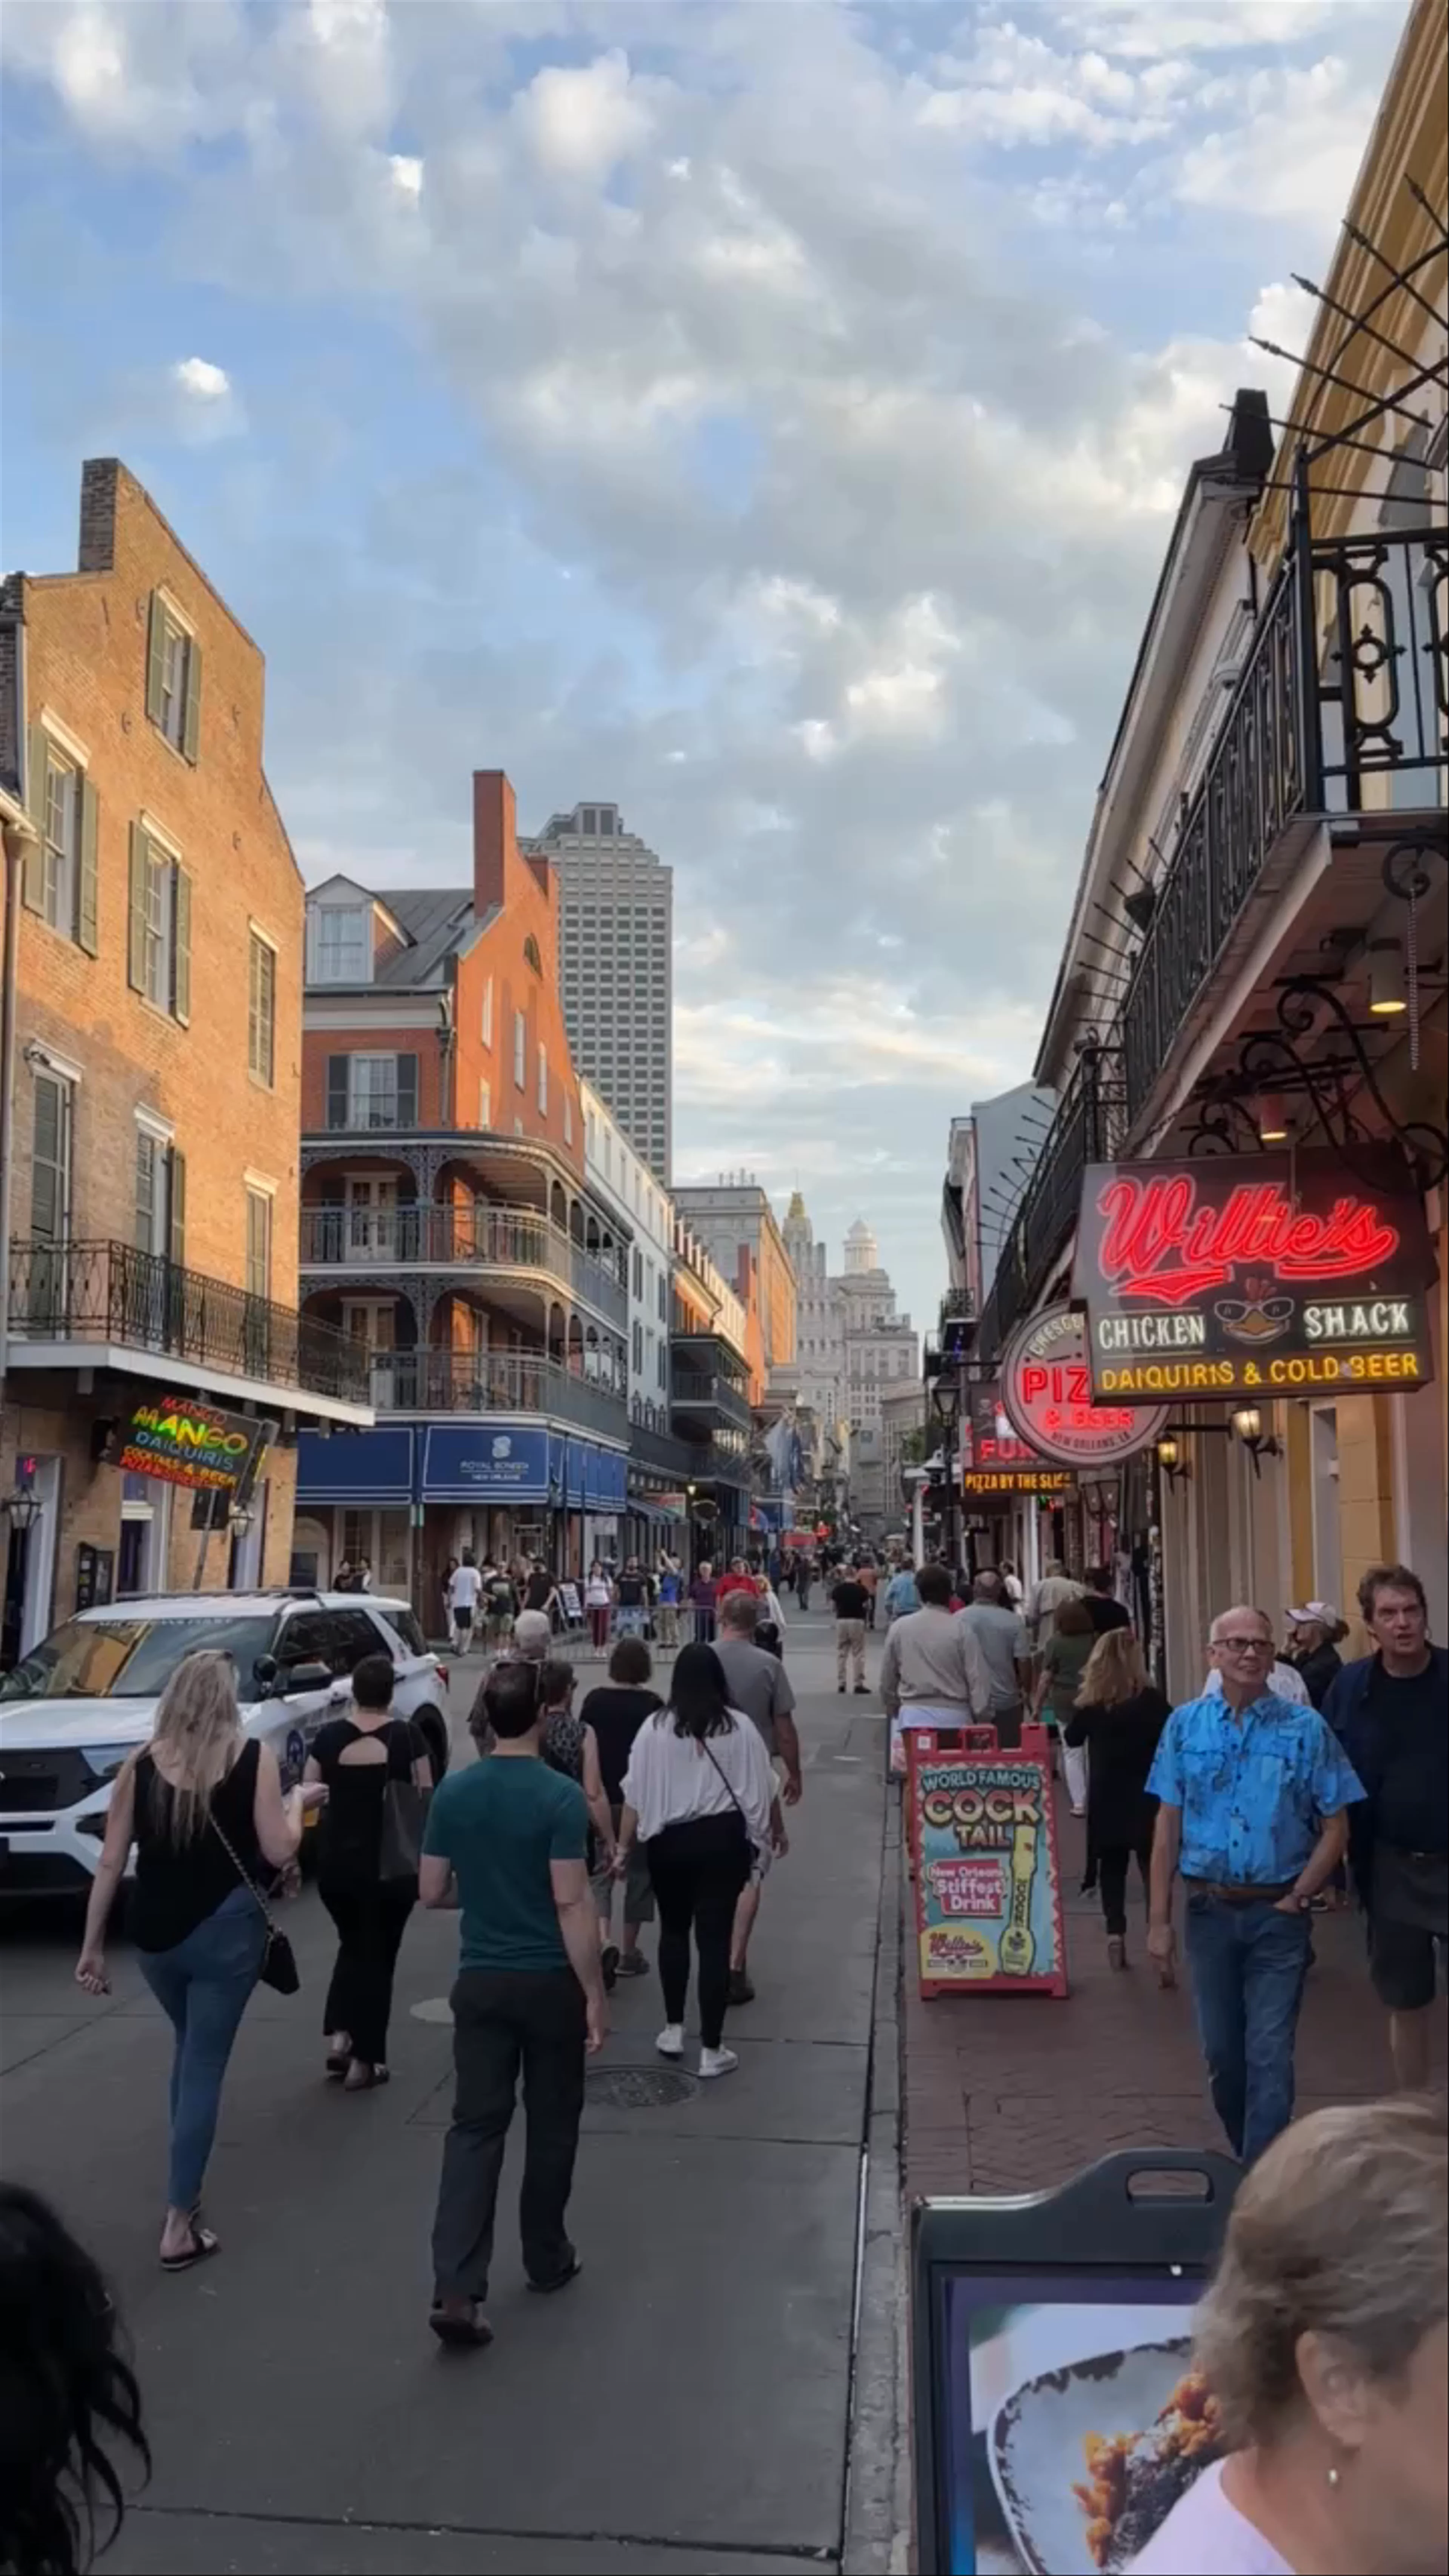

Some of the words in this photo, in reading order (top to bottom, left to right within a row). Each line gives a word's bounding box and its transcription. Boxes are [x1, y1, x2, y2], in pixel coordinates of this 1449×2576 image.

[1097, 1173, 1400, 1282] Willie's
[1029, 1313, 1084, 1356] CRESCE
[1098, 1314, 1205, 1350] CHICKEN
[1303, 1302, 1409, 1340] SHACK
[1021, 1366, 1091, 1404] PIZ
[1101, 1361, 1235, 1391] DAIQUIRIS
[1244, 1363, 1261, 1385] &
[1270, 1357, 1339, 1384] COLD
[1349, 1352, 1418, 1378] BEER
[132, 1406, 248, 1455] MANGO
[136, 1431, 234, 1471] DAIQUIRIS
[965, 1473, 998, 1489] PIZZA
[1000, 1473, 1014, 1489] BY
[1018, 1473, 1037, 1489] THE
[924, 1772, 977, 1791] WORLD
[979, 1770, 1040, 1789] FAMOUS
[925, 1790, 1040, 1824] COCK
[956, 1826, 1011, 1847] TAIL
[937, 1878, 1002, 1895] Stiffest
[951, 1894, 996, 1910] Drink
